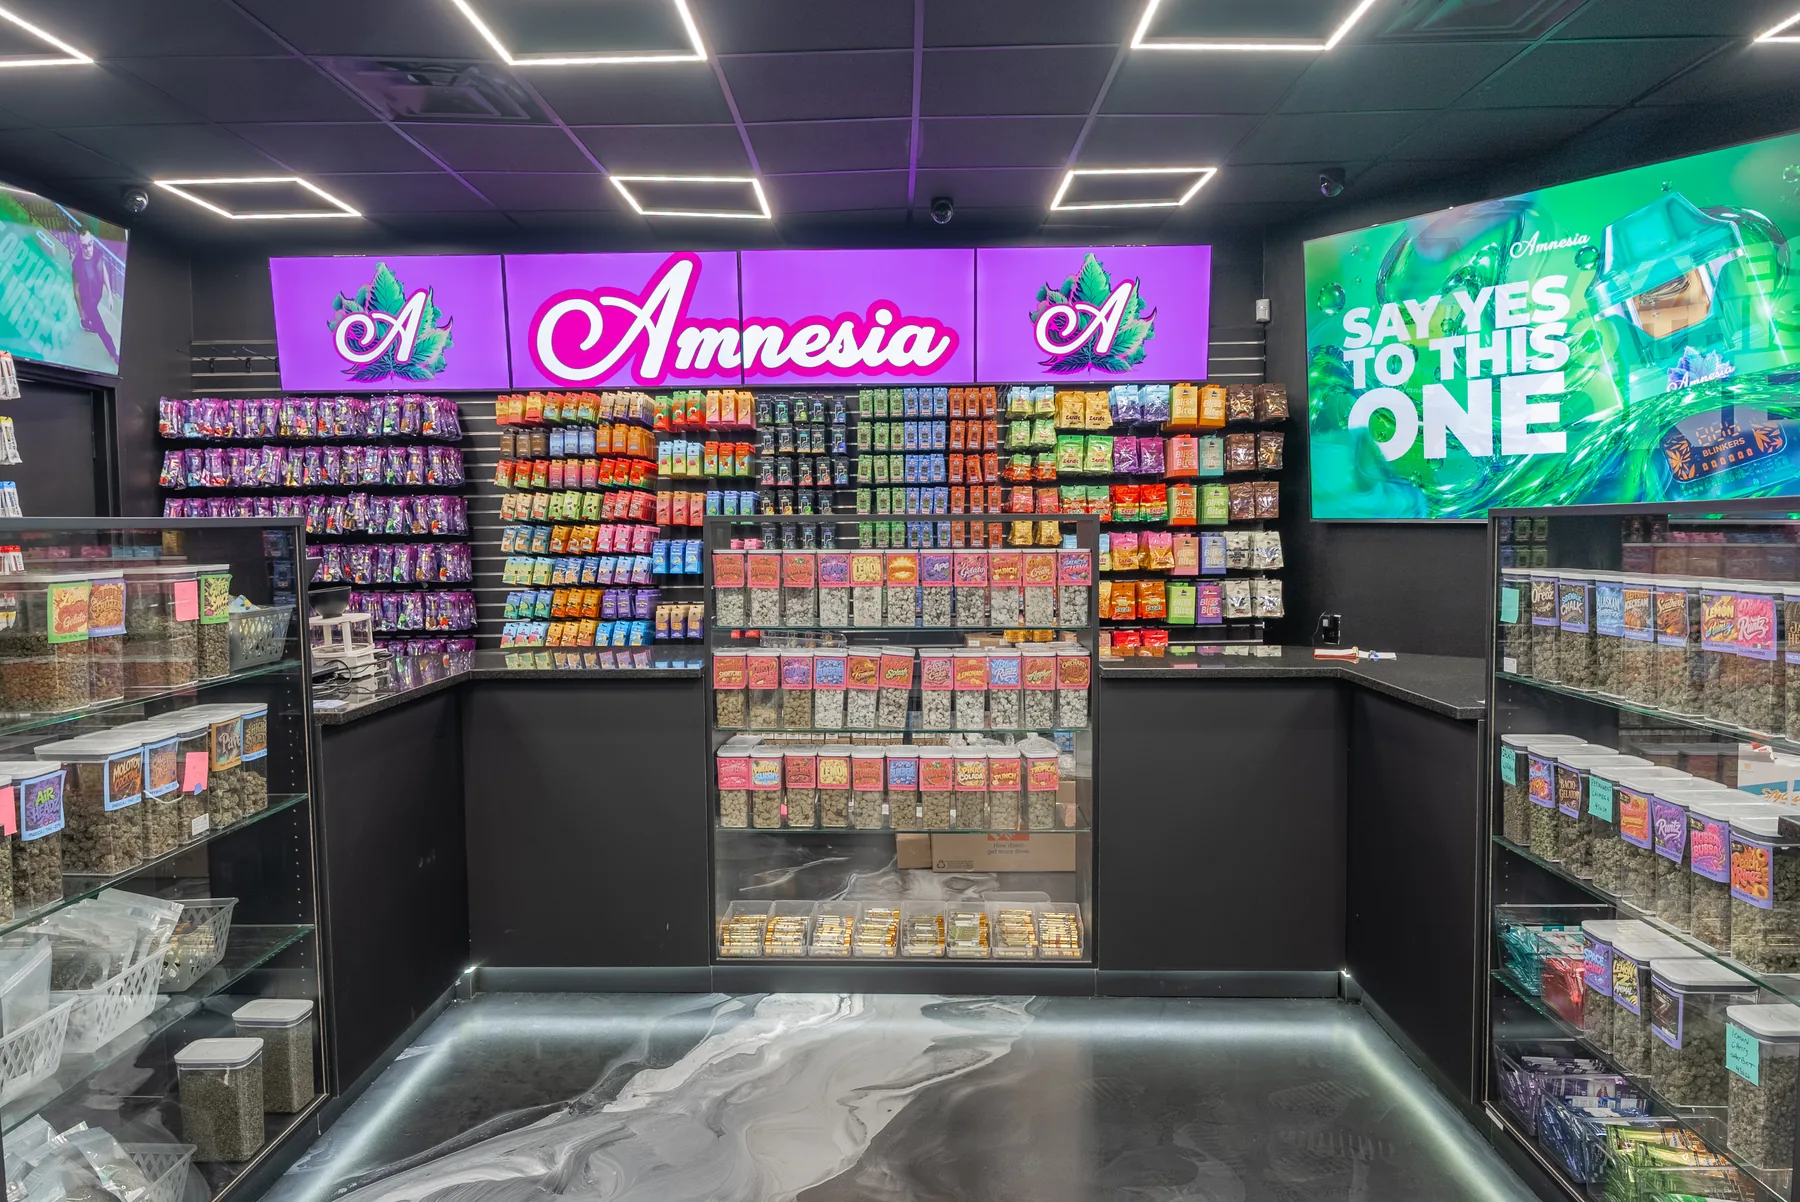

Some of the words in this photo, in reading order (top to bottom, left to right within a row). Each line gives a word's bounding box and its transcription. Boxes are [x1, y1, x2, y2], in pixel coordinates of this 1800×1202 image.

[1509, 231, 1591, 259] Amnesia
[536, 259, 951, 381] Amnesia
[1343, 295, 1442, 349] SAY
[1453, 275, 1570, 332] YES
[1343, 343, 1416, 389] TO
[1429, 322, 1570, 381] THIS
[1666, 364, 1736, 392] Amnesia
[1348, 371, 1567, 461] ONE
[1702, 437, 1746, 458] BLINKERS
[854, 563, 881, 575] LEMON
[1561, 601, 1583, 615] CHALK
[1705, 605, 1735, 619] LEMON
[1655, 819, 1682, 840] Runtz
[1690, 831, 1720, 845] HUBBA
[1692, 843, 1720, 854] BUBBA
[1583, 948, 1604, 966] SPACE
[1584, 961, 1606, 976] CANDY
